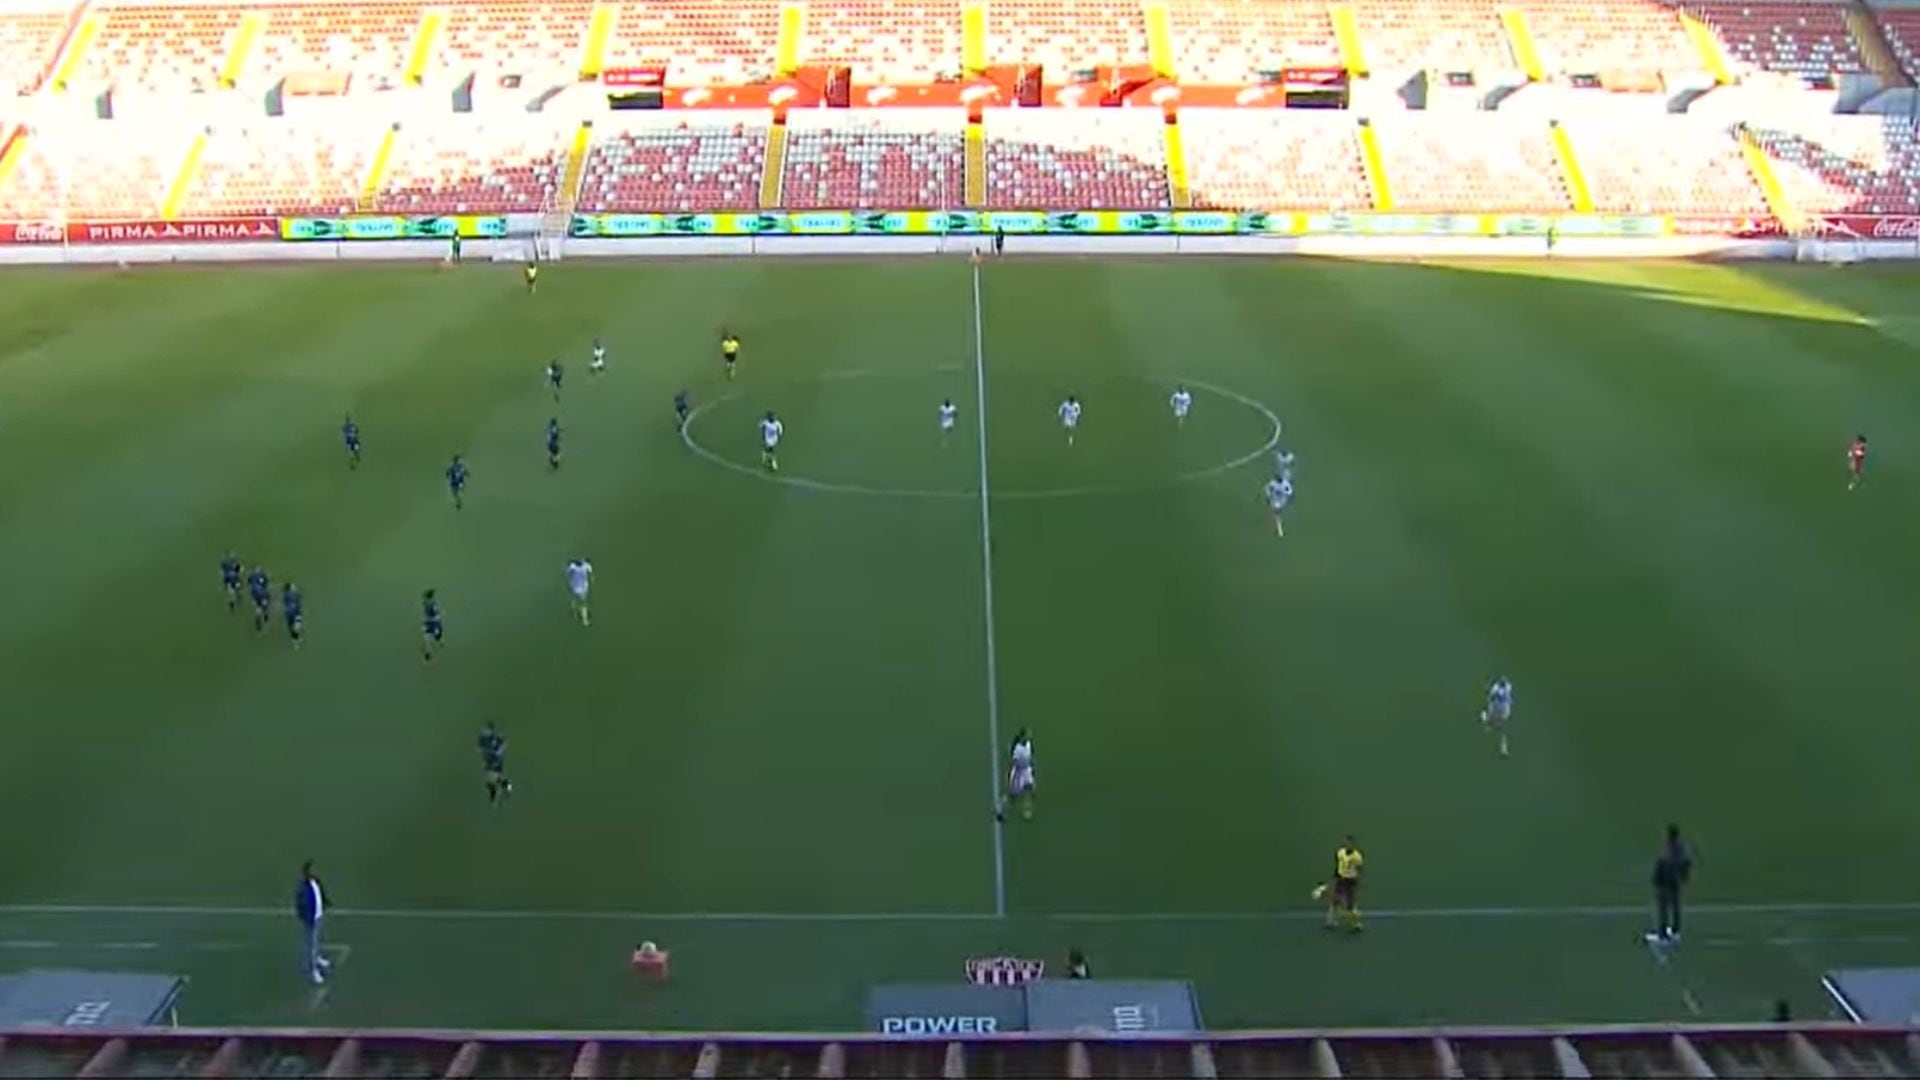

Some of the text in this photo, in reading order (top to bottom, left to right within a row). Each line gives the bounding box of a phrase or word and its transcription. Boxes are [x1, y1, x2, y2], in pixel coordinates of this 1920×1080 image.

[89, 222, 250, 239] PIRMA PIRMA
[883, 1017, 997, 1035] POWER
